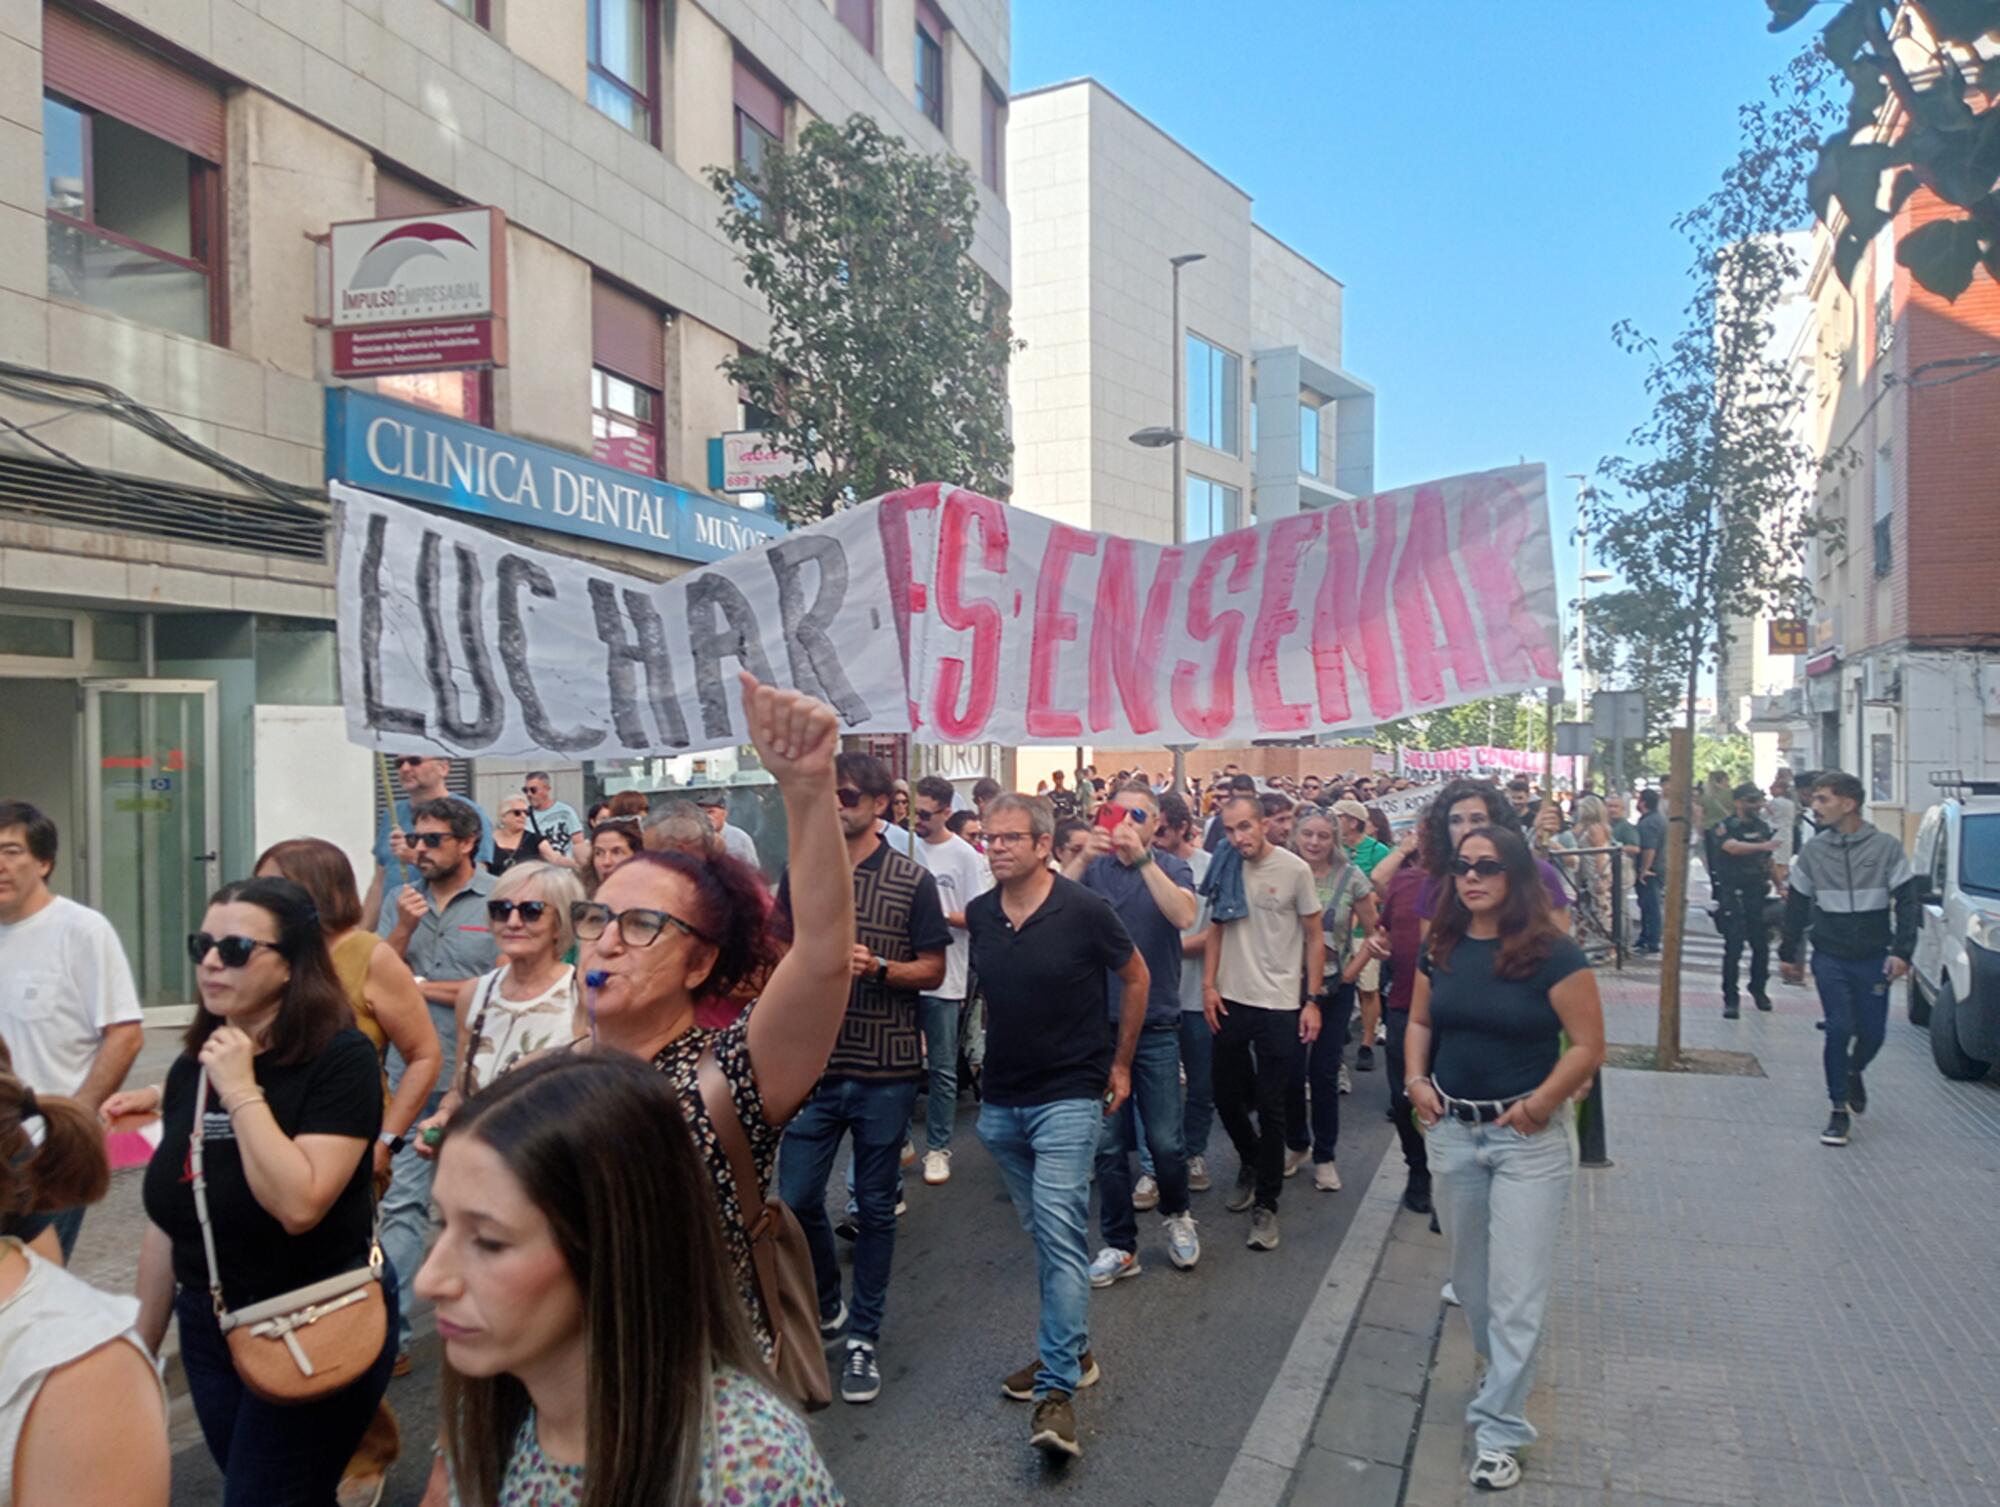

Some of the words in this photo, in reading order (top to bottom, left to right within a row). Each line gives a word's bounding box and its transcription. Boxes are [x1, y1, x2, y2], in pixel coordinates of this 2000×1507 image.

[366, 417, 541, 510] CLINICA
[551, 466, 670, 539] DENTAL
[360, 514, 873, 751] LUCHAR
[878, 482, 1010, 744] ES
